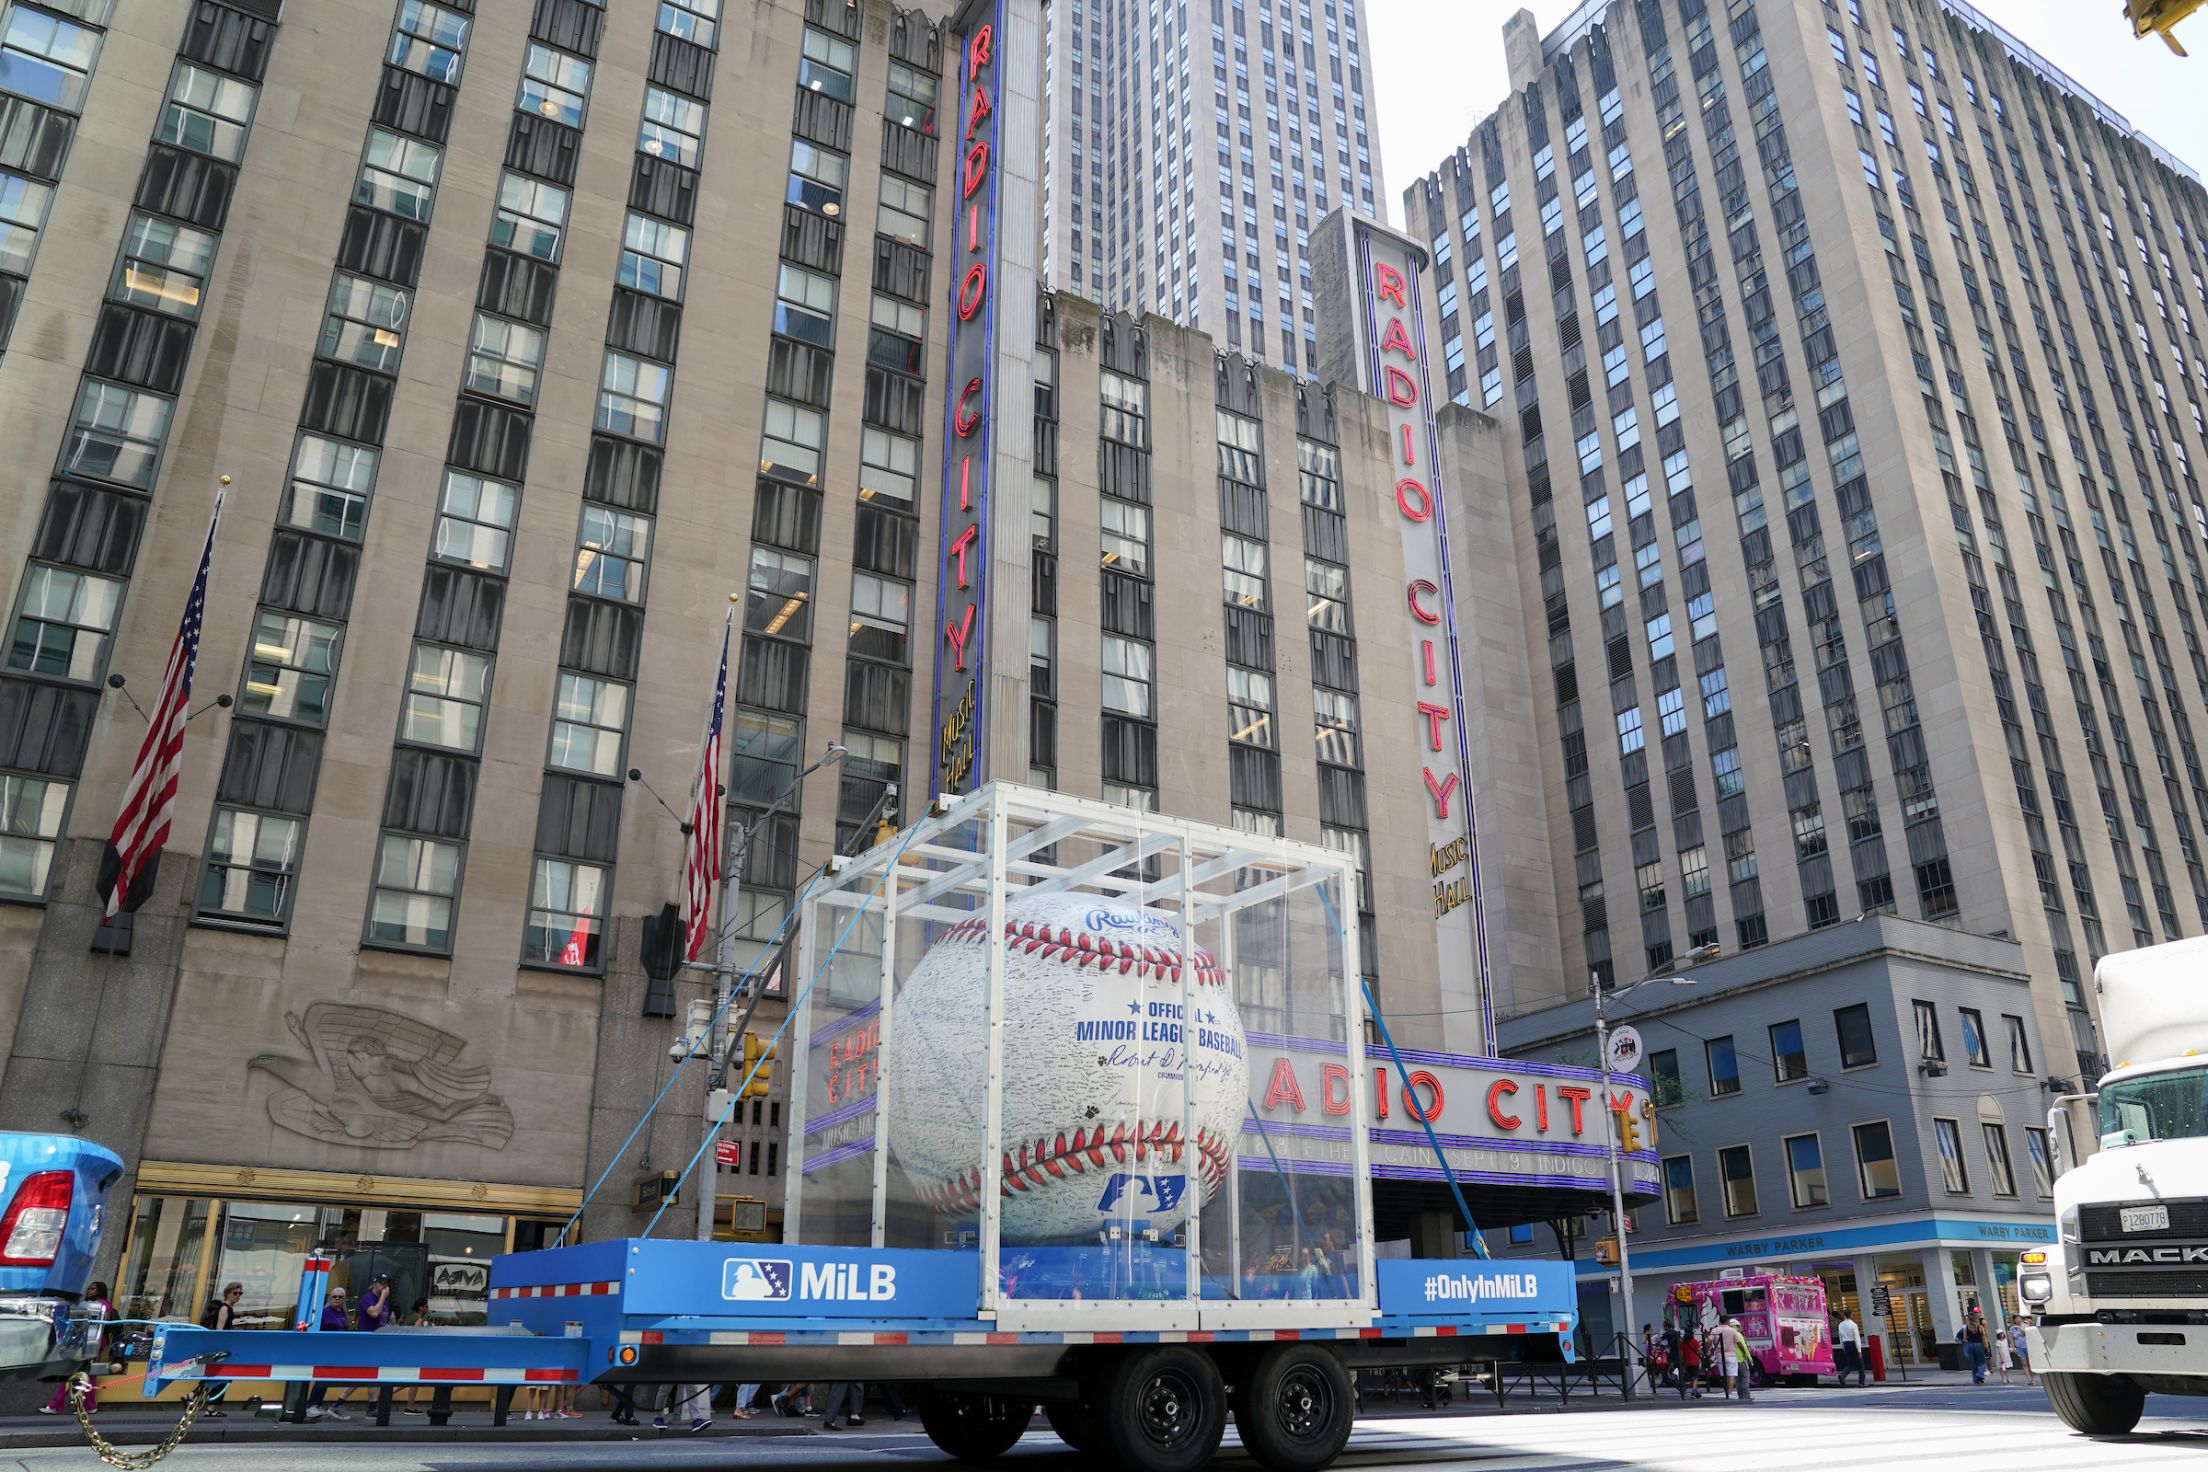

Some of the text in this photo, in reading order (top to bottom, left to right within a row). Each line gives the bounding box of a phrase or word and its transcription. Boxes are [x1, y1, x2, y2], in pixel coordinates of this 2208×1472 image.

[946, 23, 993, 674] RADIO CITY
[1376, 261, 1460, 821] RADIO CITY
[942, 680, 976, 767] MUSIC
[945, 731, 975, 794] HALL
[1433, 877, 1472, 920] HALL
[1148, 1001, 1204, 1024] OFFICL
[829, 1017, 880, 1071] RADIO
[1076, 1020, 1243, 1061] MINOR LEAGU BASEBALL
[1263, 1056, 1445, 1124] ADIO
[1486, 1078, 1634, 1136] CITY
[1383, 1145, 1431, 1166] CAIN
[1452, 1149, 1495, 1169] SEPT
[1509, 1153, 1520, 1170] 9
[1538, 1154, 1597, 1176] INDIGO
[1726, 1236, 1825, 1257] WARBY PARKER
[1977, 1225, 2050, 1240] WARBY PARKER
[2089, 1246, 2208, 1264] MACK
[800, 1262, 896, 1301] MiLB
[1424, 1273, 1538, 1304] #OnlyInMiLB
